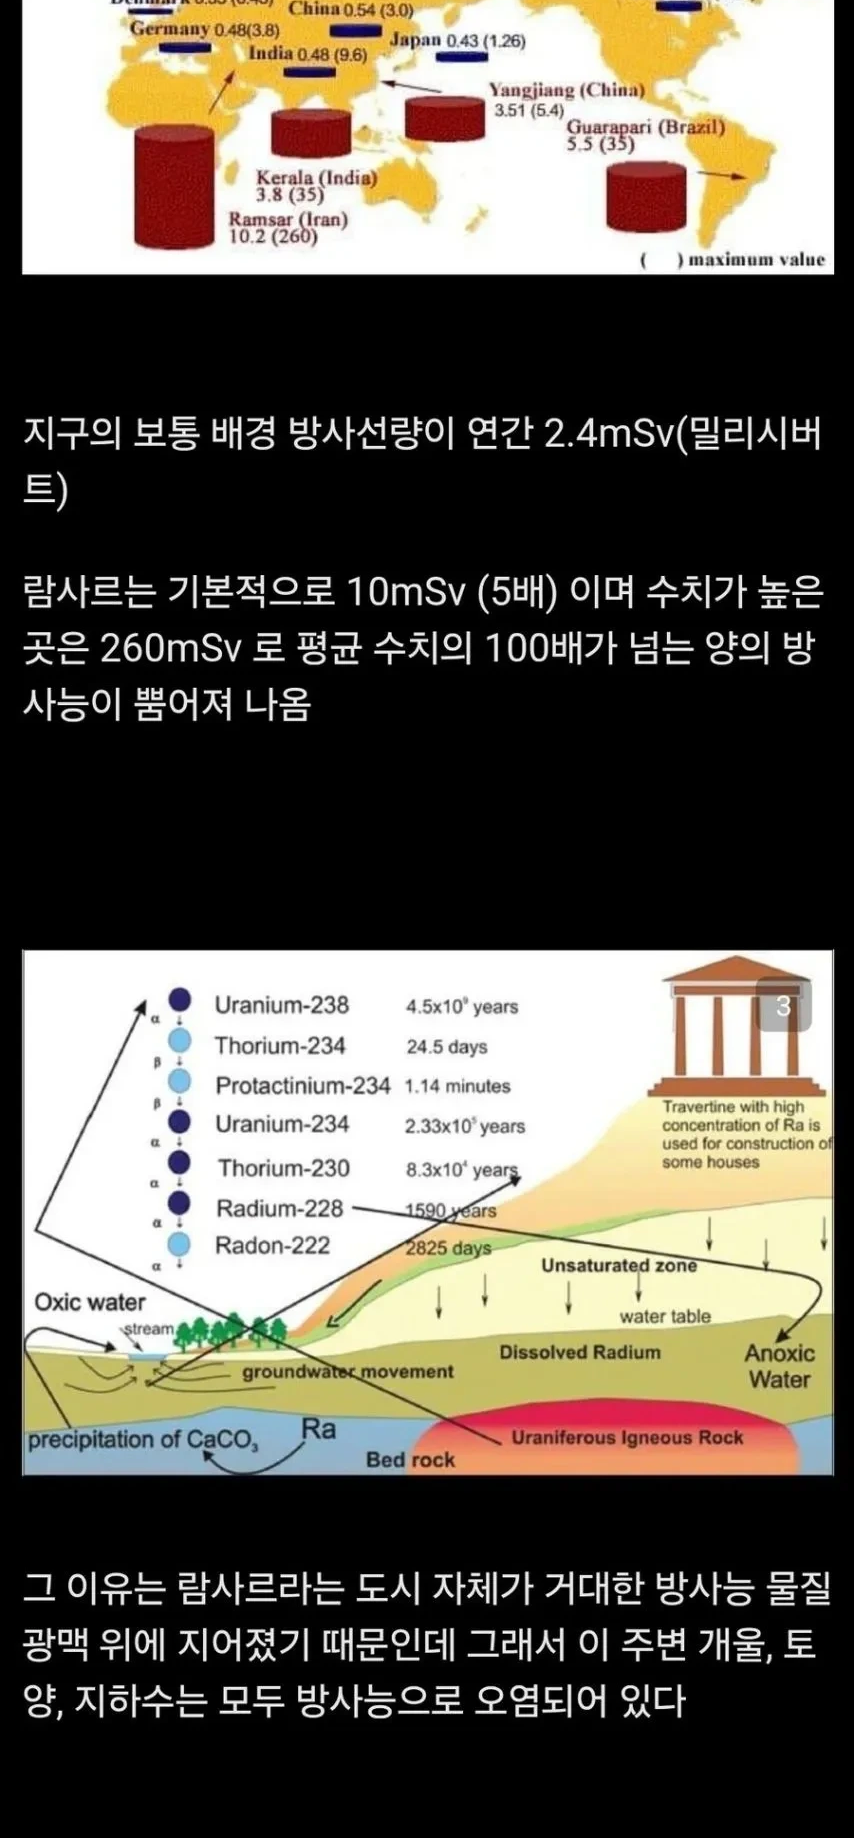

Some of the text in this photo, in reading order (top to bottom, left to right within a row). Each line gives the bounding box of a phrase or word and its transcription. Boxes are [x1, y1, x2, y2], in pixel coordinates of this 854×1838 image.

[288, 0, 414, 19] China 0.54 (3.0)
[390, 31, 526, 51] Japan 0.43 (1.26)
[490, 82, 645, 101] Yangjiang (China)
[567, 119, 726, 138] Guarapari (Brazil)
[229, 211, 349, 229] Ramsar (Iran)
[230, 229, 319, 247] 10.2 (260)
[688, 251, 826, 268] maximum value
[23, 688, 311, 722] 사능이 뿜어져 나옴
[215, 995, 350, 1015] Uranium-238
[215, 1036, 488, 1057] Thorium-234 24.5 days
[216, 1076, 511, 1095] Protactinium-234 1.14 minutes
[663, 1100, 805, 1116] Travertine with high
[218, 1159, 350, 1178] Thorium-230
[662, 1155, 760, 1169] some houses
[217, 1199, 343, 1218] Radium-228
[216, 1236, 330, 1255] Radon-222
[542, 1258, 698, 1274] Unsaturated zone
[35, 1293, 146, 1312] Oxic water
[620, 1309, 712, 1324] water table
[124, 1323, 175, 1336] stream
[500, 1344, 662, 1360] Dissolved Radium
[744, 1344, 815, 1363] Anoxic
[242, 1365, 455, 1382] groundwater movement
[749, 1370, 811, 1389] Water
[302, 1418, 337, 1440] Ra
[512, 1430, 744, 1448] Uraniferous Igneous Rock
[366, 1452, 455, 1469] Bed rock
